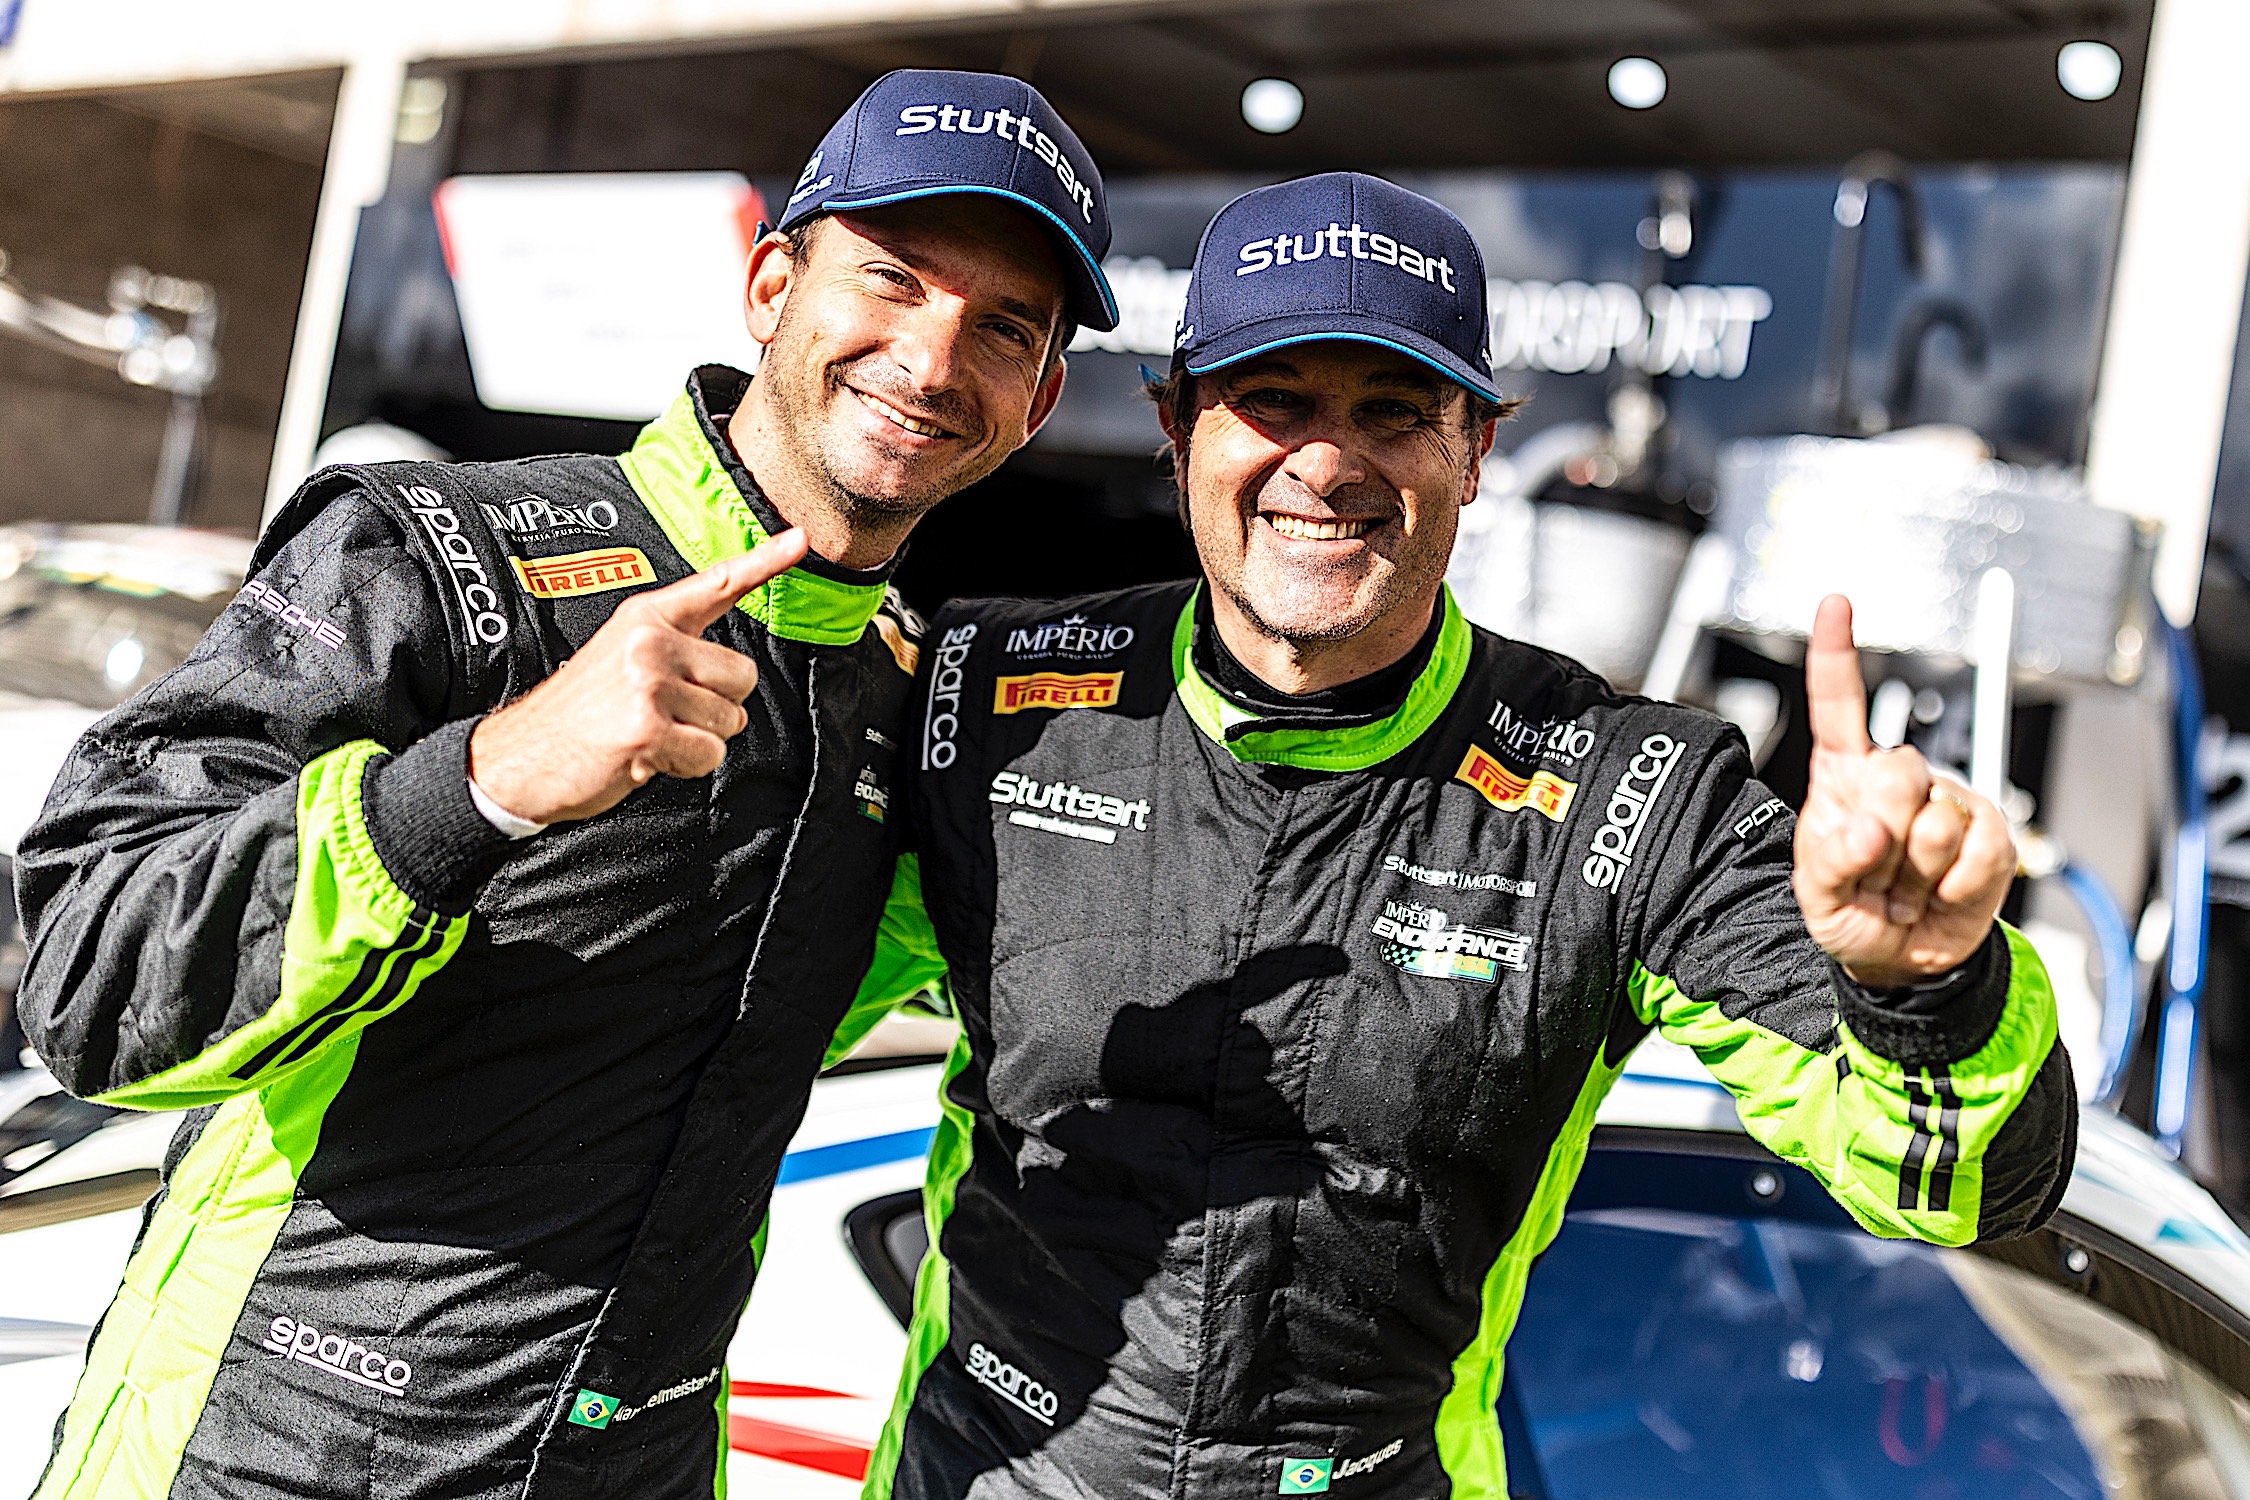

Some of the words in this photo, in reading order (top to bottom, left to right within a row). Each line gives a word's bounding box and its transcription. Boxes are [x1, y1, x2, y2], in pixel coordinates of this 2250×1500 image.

[896, 104, 1094, 224] Stuttgart
[1236, 222, 1456, 294] Stuttgart
[396, 484, 509, 646] sparco
[523, 553, 643, 592] PIRELLI
[922, 622, 978, 771] sparco
[1004, 678, 1115, 708] PIRELLI
[988, 771, 1151, 832] Stuttgart
[1582, 732, 1687, 894] sparco
[1371, 915, 1529, 964] ENDURANCE
[262, 1315, 412, 1398] sparco
[965, 1341, 1059, 1427] sparco
[1331, 1438, 1404, 1480] Jacques
